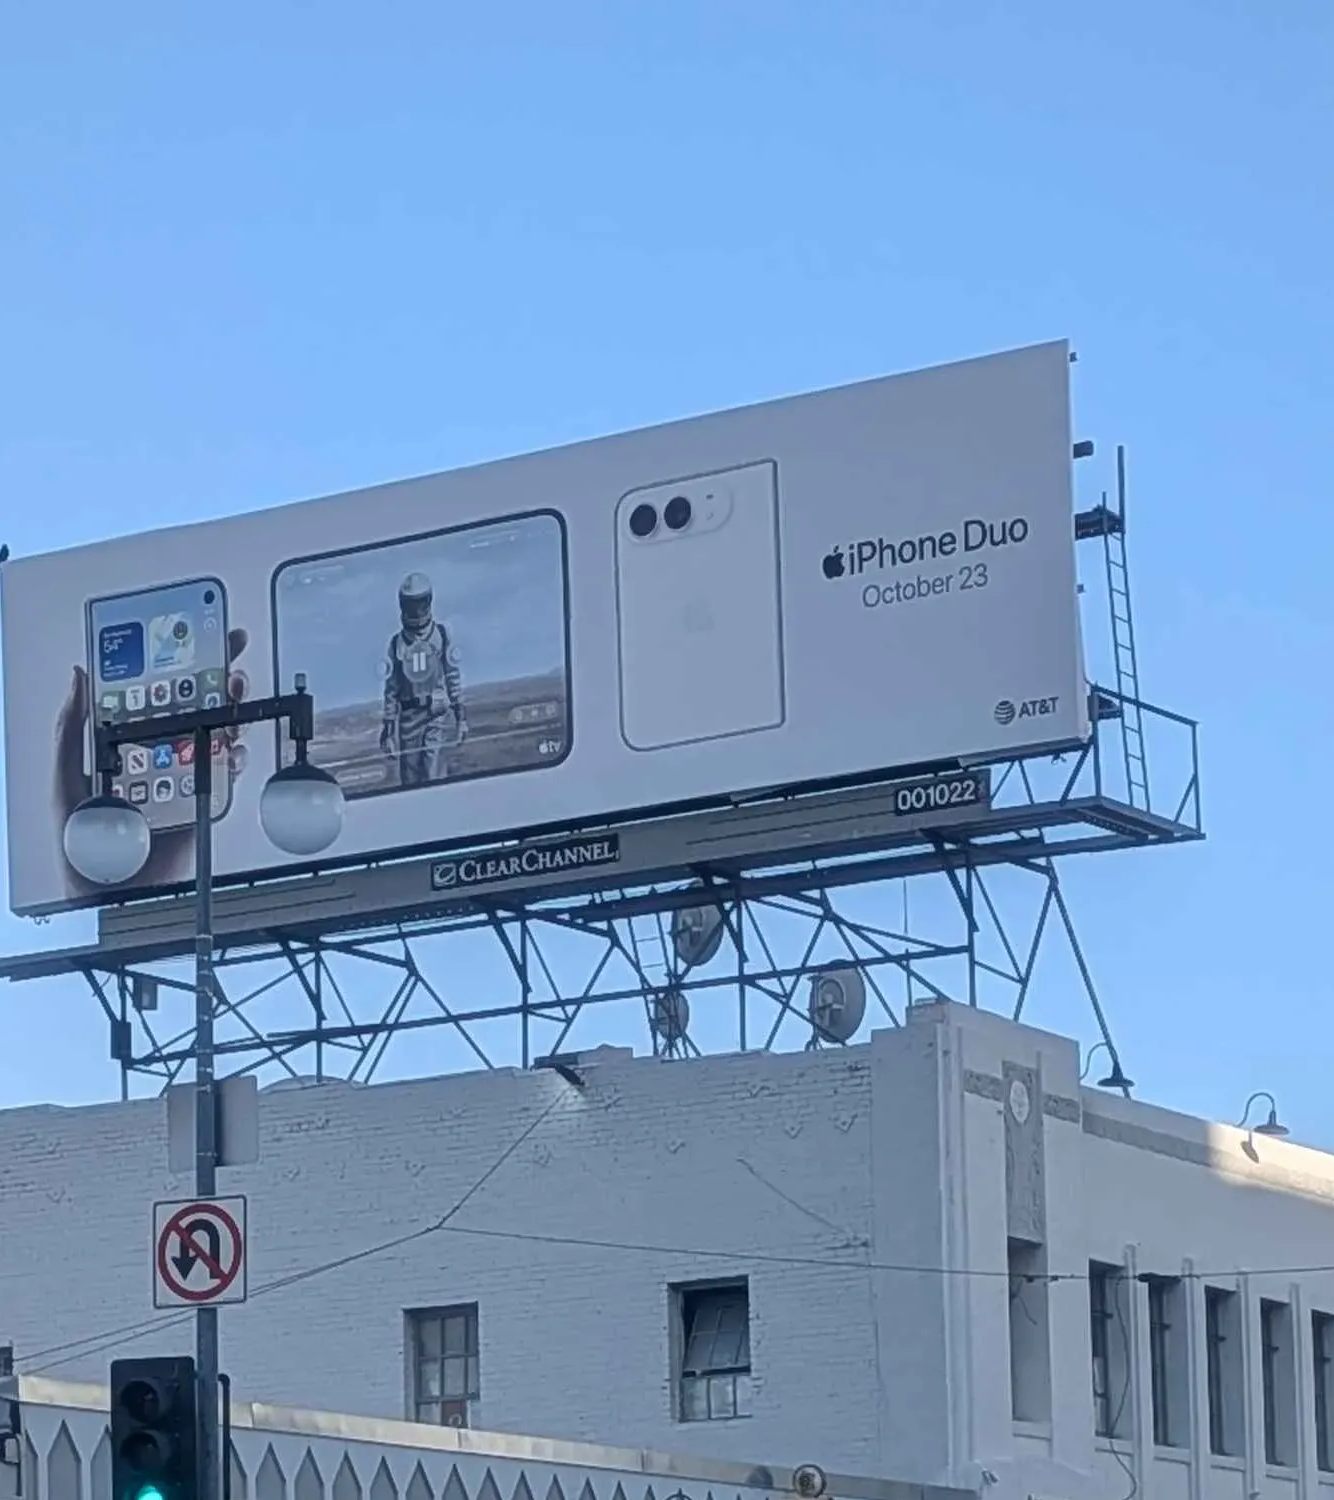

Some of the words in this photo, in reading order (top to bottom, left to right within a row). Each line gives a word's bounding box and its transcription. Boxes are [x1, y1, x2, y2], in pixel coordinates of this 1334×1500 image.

[849, 531, 957, 575] iPhone
[963, 518, 1029, 552] Duo
[862, 574, 954, 608] October
[959, 563, 989, 590] 23
[1018, 697, 1060, 718] AT&T
[897, 780, 976, 810] 001022
